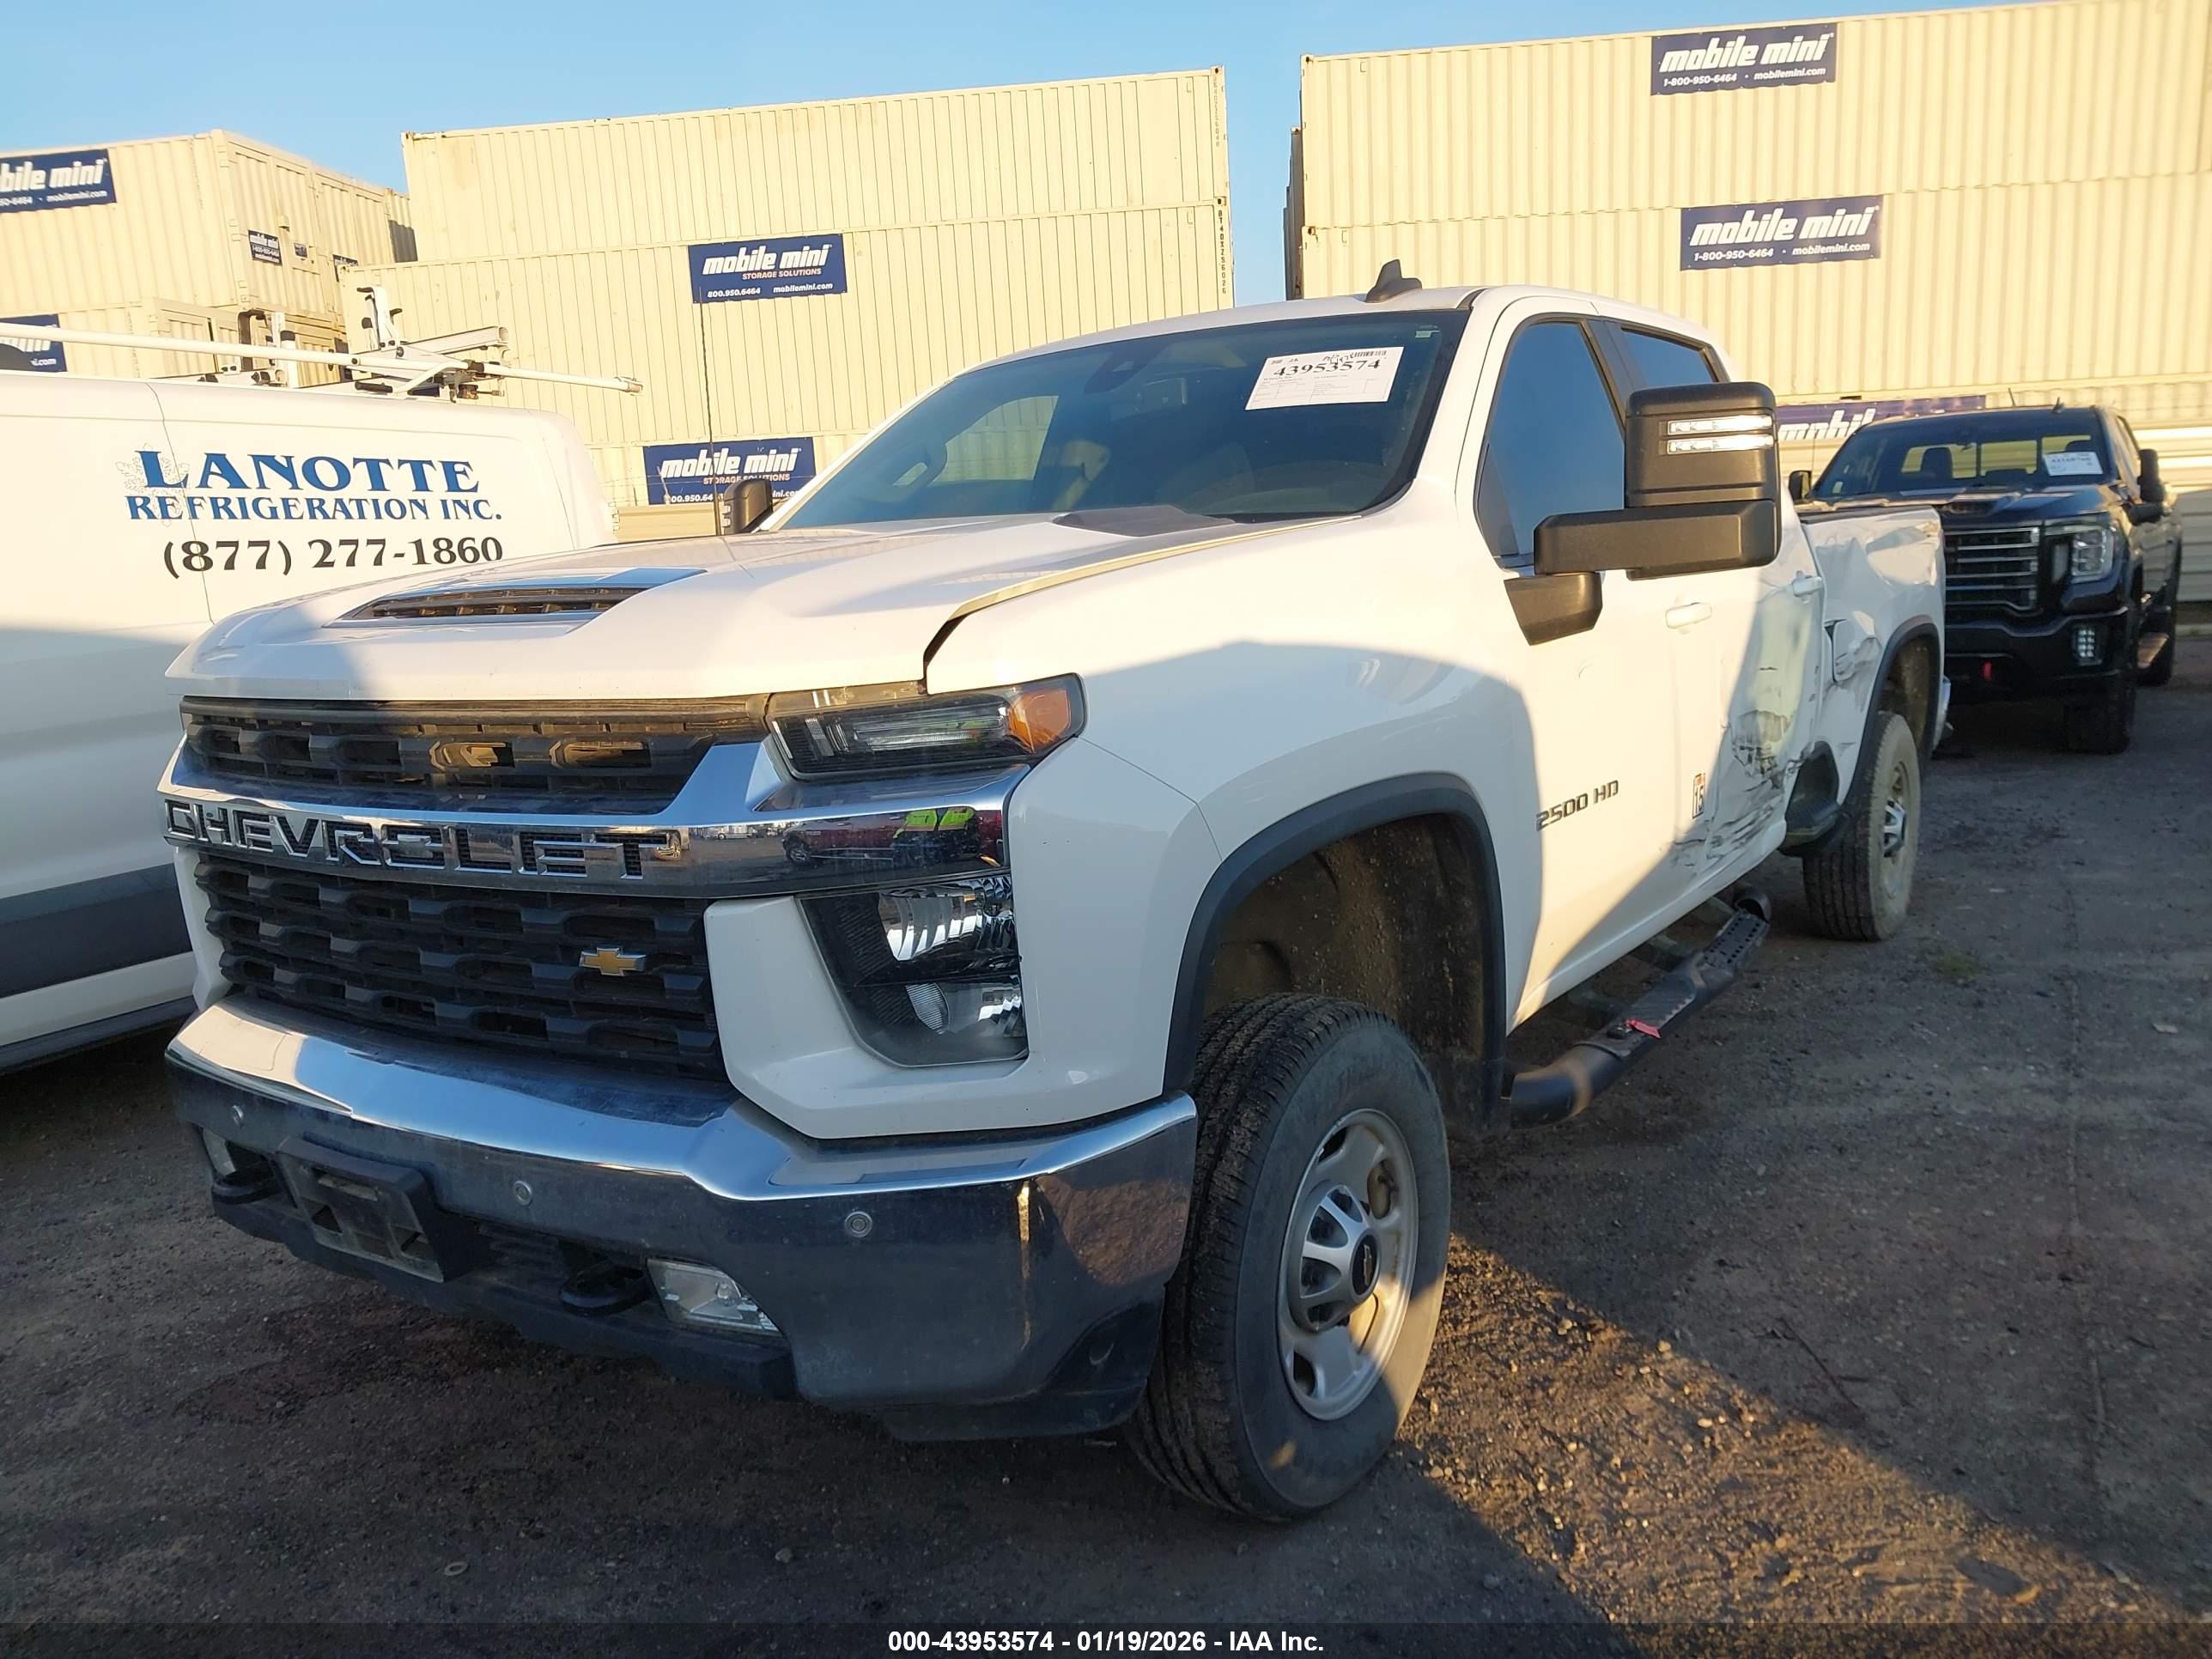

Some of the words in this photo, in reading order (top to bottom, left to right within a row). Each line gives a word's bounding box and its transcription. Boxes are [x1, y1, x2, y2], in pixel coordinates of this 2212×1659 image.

[1659, 35, 1759, 72] mobile
[1760, 33, 1831, 65] mini
[1663, 73, 1737, 87] 1-800-950-6464
[1753, 68, 1826, 81] mobilemini.com
[0, 161, 46, 192] bile
[49, 159, 103, 188] mini
[1690, 208, 1798, 246] mobile
[1799, 206, 1875, 240] mini
[702, 246, 777, 275] mobile
[779, 244, 830, 270] mini
[1693, 248, 1774, 261] 1-800-950-6464
[1792, 242, 1871, 256] mobilemini.com
[742, 270, 777, 280] STORAGE
[778, 268, 822, 277] SOLUTIONS
[707, 287, 761, 298] 800.950.6464
[773, 282, 834, 294] mobilemini.com
[1273, 359, 1382, 376] 43953574
[134, 450, 480, 493] LANOTTE
[660, 447, 741, 478] mobile
[744, 447, 799, 474] mini
[125, 495, 430, 520] REFRIGERATION
[439, 498, 502, 520] INC.
[163, 539, 292, 580] (877)
[307, 536, 503, 568] 277-1860
[1535, 793, 1589, 831] 2500
[1594, 780, 1619, 804] HD
[164, 799, 673, 879] CHEVROLET
